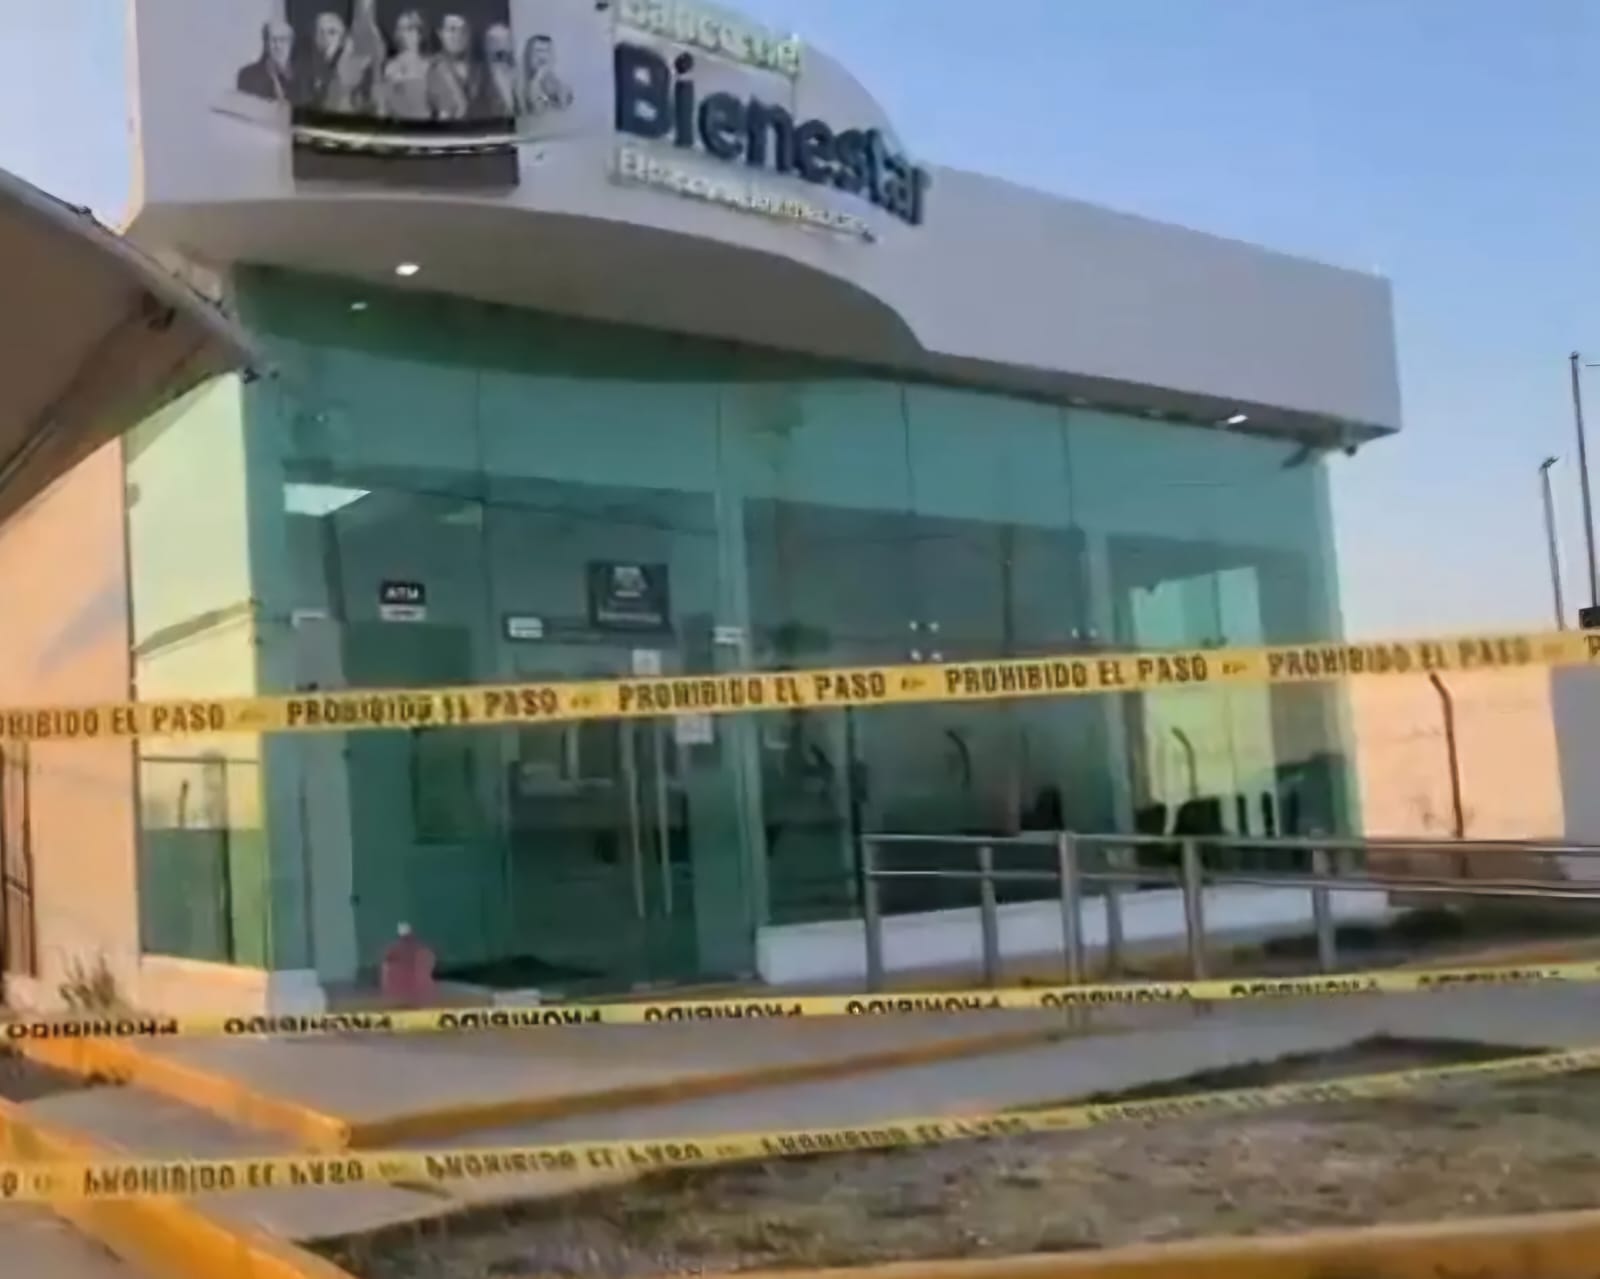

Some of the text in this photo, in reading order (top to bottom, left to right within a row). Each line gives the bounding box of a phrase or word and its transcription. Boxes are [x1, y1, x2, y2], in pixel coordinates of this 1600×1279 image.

[614, 41, 930, 225] Bienestar
[0, 708, 98, 738] HIBIDO
[112, 706, 139, 735] EL
[153, 703, 225, 732] PASO
[484, 688, 557, 717] PASO
[618, 676, 764, 712] PROHIBIDO
[776, 675, 801, 703] EL
[814, 671, 887, 702] PASO
[946, 660, 1087, 694] PROHIBIDO
[1100, 660, 1125, 686] EL
[1138, 655, 1208, 683] PASO
[1268, 644, 1413, 678] PROHIBIDO
[1419, 643, 1449, 669] EL
